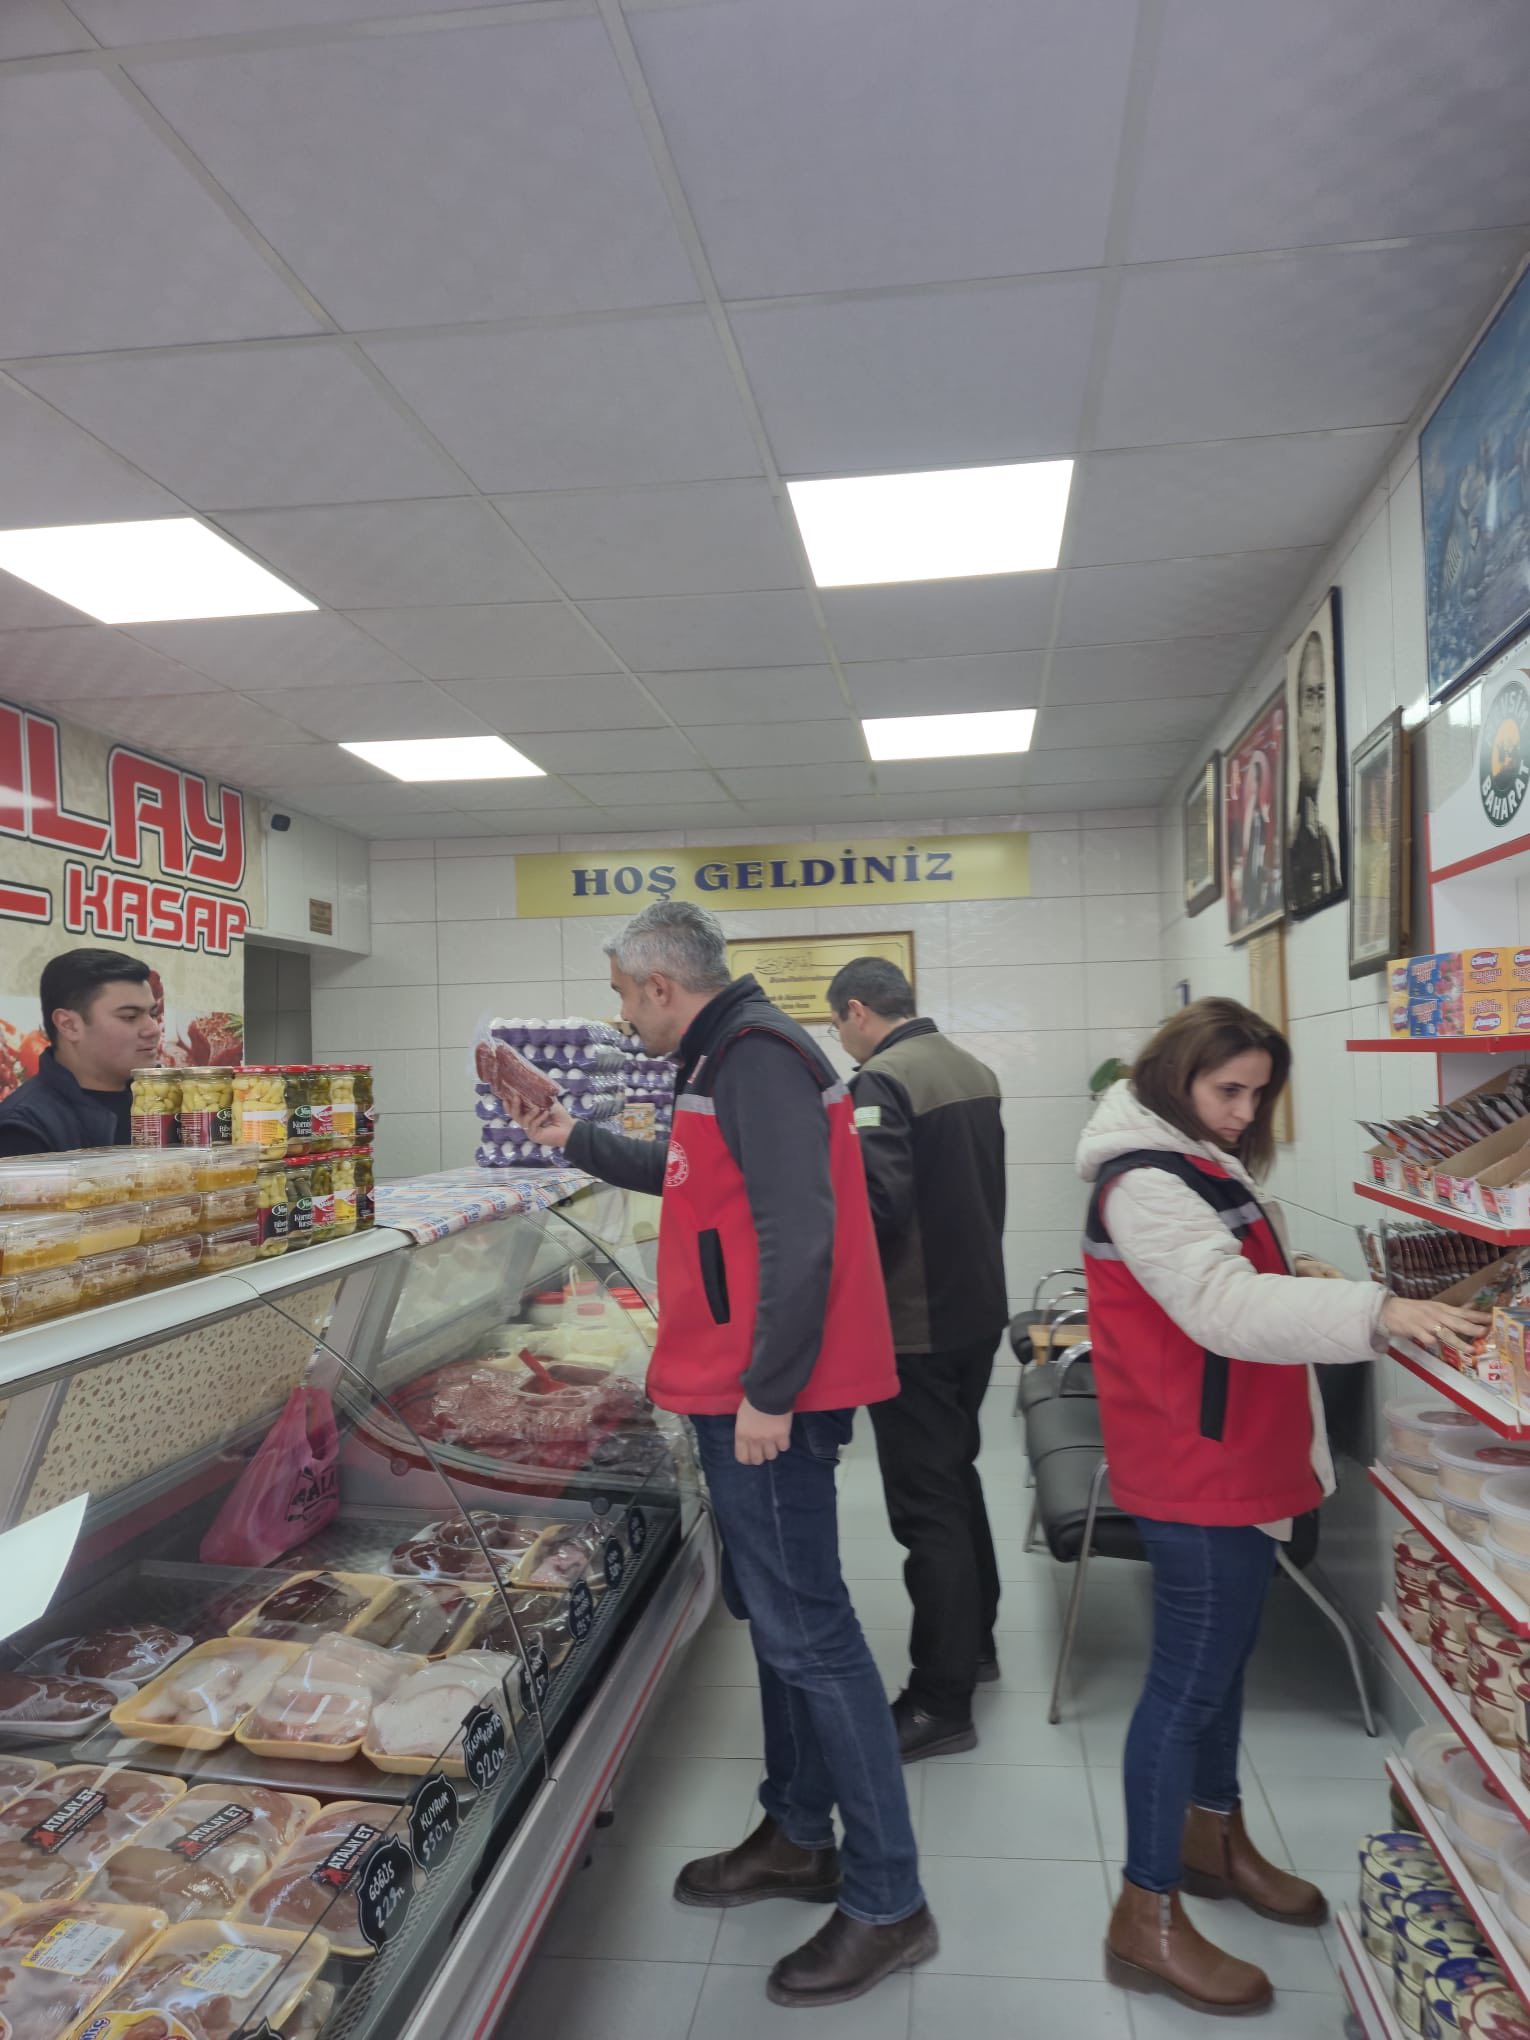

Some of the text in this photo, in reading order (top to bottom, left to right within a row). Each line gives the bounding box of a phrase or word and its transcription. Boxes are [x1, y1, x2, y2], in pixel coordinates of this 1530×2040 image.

[1482, 760, 1529, 821] BAHARAT
[571, 845, 954, 902] HOŞ GELDİNİZ
[64, 859, 250, 957] KASAP
[42, 1799, 83, 1832] ATALAY
[76, 1789, 96, 1803] ET
[187, 1815, 230, 1841] ATALAY
[223, 1806, 243, 1818] ET
[419, 1791, 450, 1833] KUYRUK
[328, 1838, 364, 1870] ATALAY
[355, 1826, 374, 1839] ET
